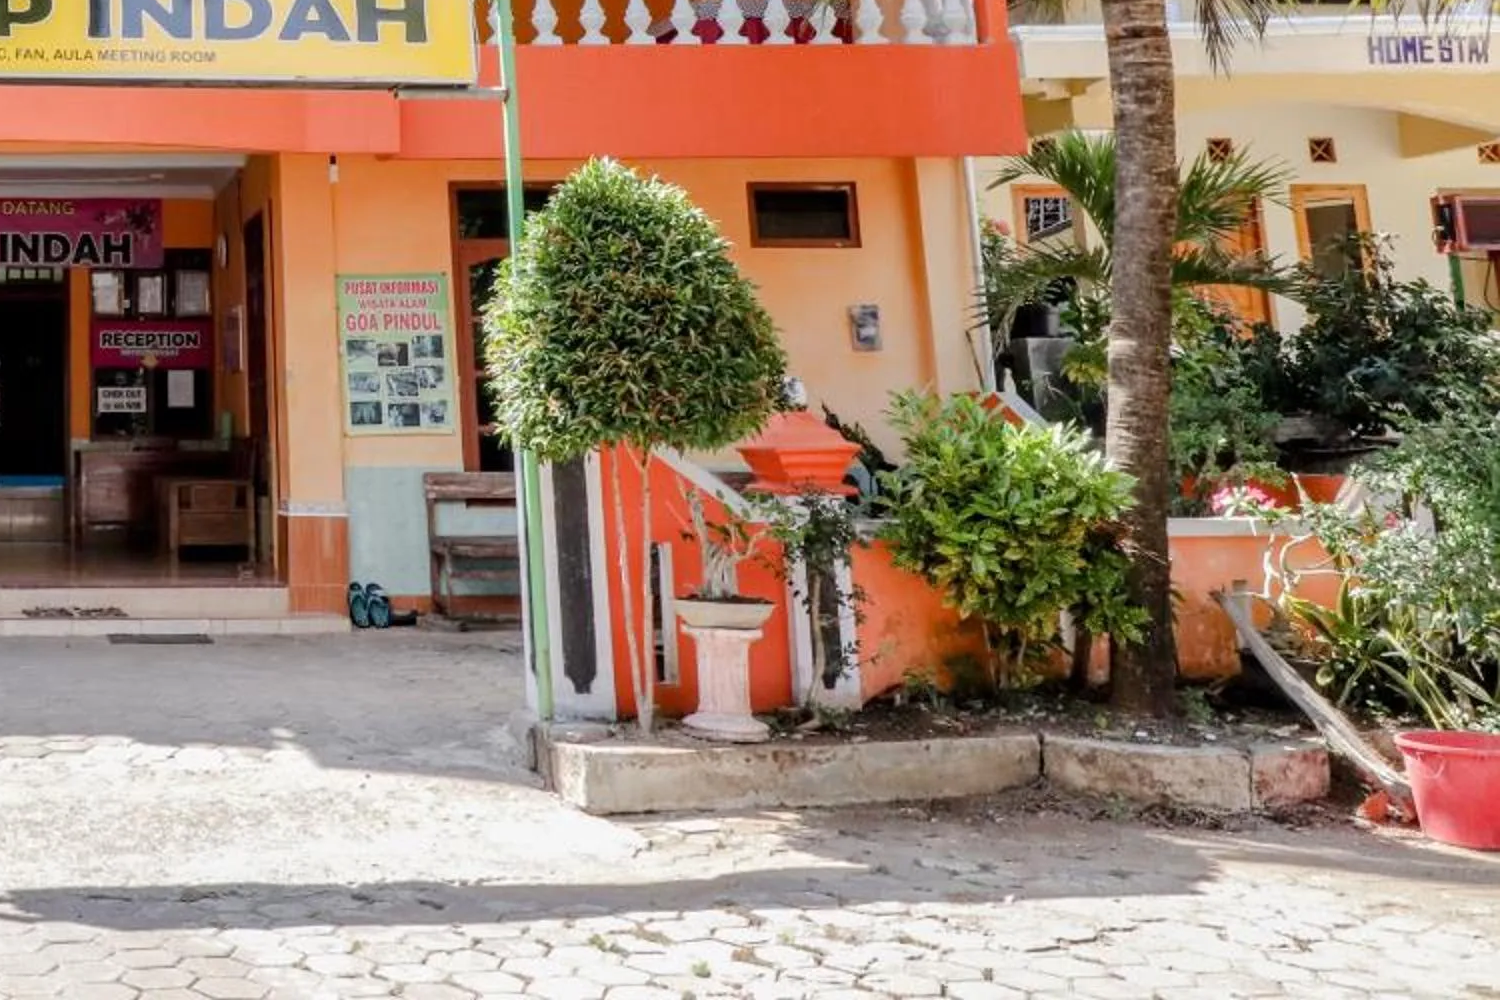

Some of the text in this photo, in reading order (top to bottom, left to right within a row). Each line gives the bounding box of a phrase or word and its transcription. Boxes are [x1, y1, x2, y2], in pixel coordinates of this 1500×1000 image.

[15, 48, 50, 62] FAN,
[53, 48, 94, 61] AULA
[98, 50, 167, 63] MEETING
[170, 51, 217, 63] ROOM
[3, 201, 76, 215] DATANG
[344, 280, 438, 295] PUSAT INFORMASI
[346, 312, 442, 331] GOA PINDUL
[100, 331, 199, 348] RECEPTION
